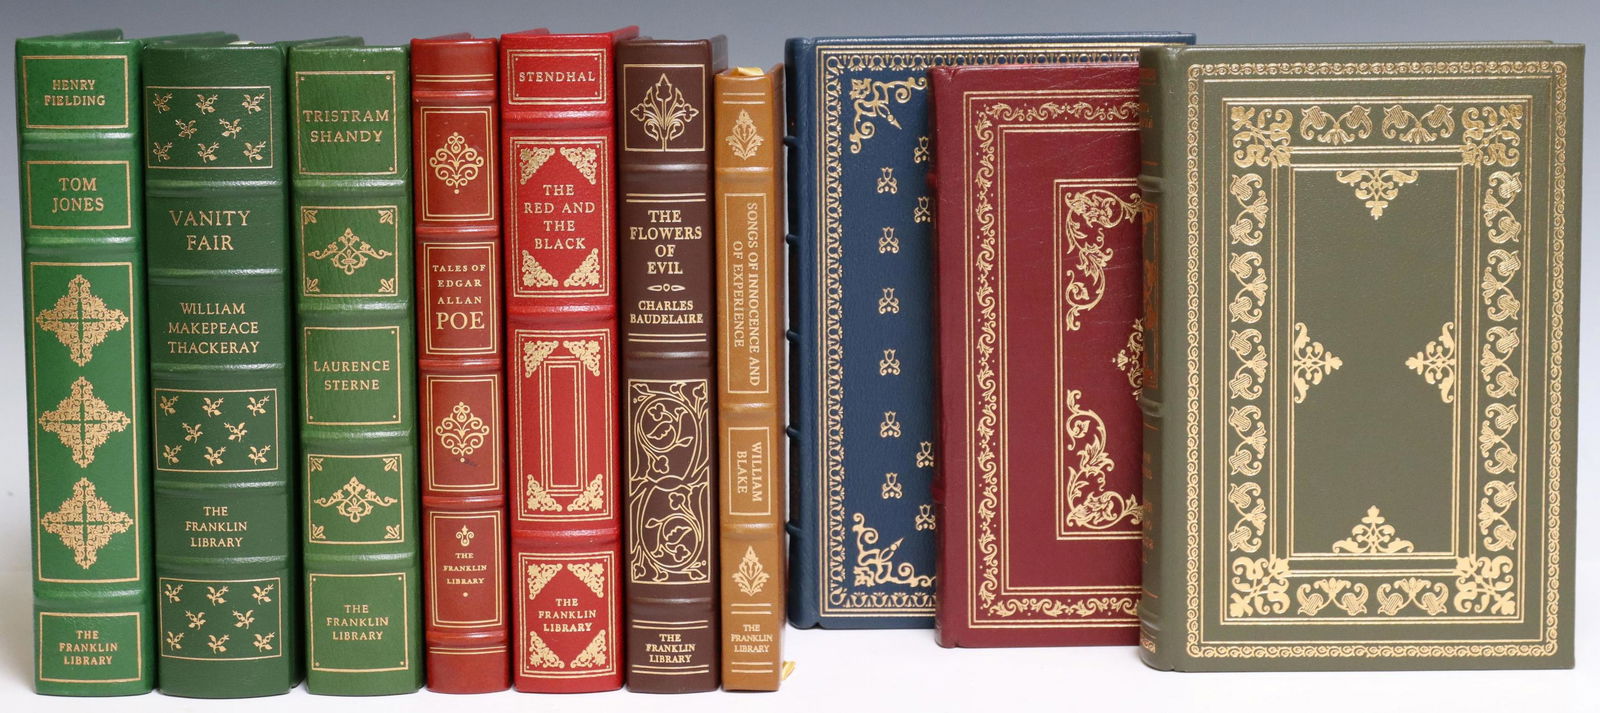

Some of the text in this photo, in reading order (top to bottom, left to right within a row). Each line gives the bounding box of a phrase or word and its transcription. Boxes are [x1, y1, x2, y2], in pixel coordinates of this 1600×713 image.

[519, 71, 596, 82] STENDHAL
[53, 79, 95, 91] HENRY
[44, 95, 106, 107] FIELDING
[303, 109, 390, 122] TRISTRAM
[310, 130, 383, 143] SHANDY
[58, 178, 97, 191] TOM
[542, 184, 574, 196] THE
[52, 197, 104, 213] JONES
[524, 202, 595, 213] RED AND
[169, 210, 251, 227] VANITY
[648, 210, 681, 222] THE
[544, 220, 575, 231] THE
[629, 226, 702, 240] FLOWERS
[186, 235, 234, 251] FAIR
[534, 238, 586, 250] BLACK
[655, 244, 675, 257] OF
[432, 264, 468, 272] TALES
[647, 262, 683, 275] EVIL
[438, 279, 482, 288] EDGAR
[733, 240, 744, 348] OF EXPERIENCE
[747, 202, 761, 386] SONGS OF INNOCENCE AND
[437, 296, 482, 304] ALLAN
[638, 300, 693, 311] CHARLES
[180, 303, 245, 315] WILLIAM
[436, 311, 485, 330] POE
[629, 313, 704, 324] BAUDELAIRE
[167, 322, 259, 334] MAKEPEACE
[167, 342, 261, 354] THACKERAY
[313, 360, 390, 372] LAURENCE
[324, 379, 380, 390] STERNE
[737, 451, 747, 493] BLAKE
[751, 442, 762, 502] WILLIAM
[203, 506, 228, 516] THE
[185, 521, 247, 532] FRANKLIN
[190, 537, 243, 548] LIBRARY
[555, 598, 578, 607] THE
[344, 604, 369, 613] THE
[538, 609, 597, 619] FRANKLIN
[326, 617, 389, 626] FRANKLIN
[543, 622, 592, 632] LIBRARY
[742, 624, 761, 632] THE
[75, 630, 98, 640] THE
[332, 630, 383, 640] LIBRARY
[659, 634, 682, 643] THE
[731, 634, 773, 642] FRANKLIN
[58, 642, 118, 652] FRANKLIN
[645, 644, 696, 653] FRANKLIN
[734, 644, 770, 653] LIBRARY
[64, 655, 113, 666] LIBRARY
[649, 654, 692, 664] LIBRARY
